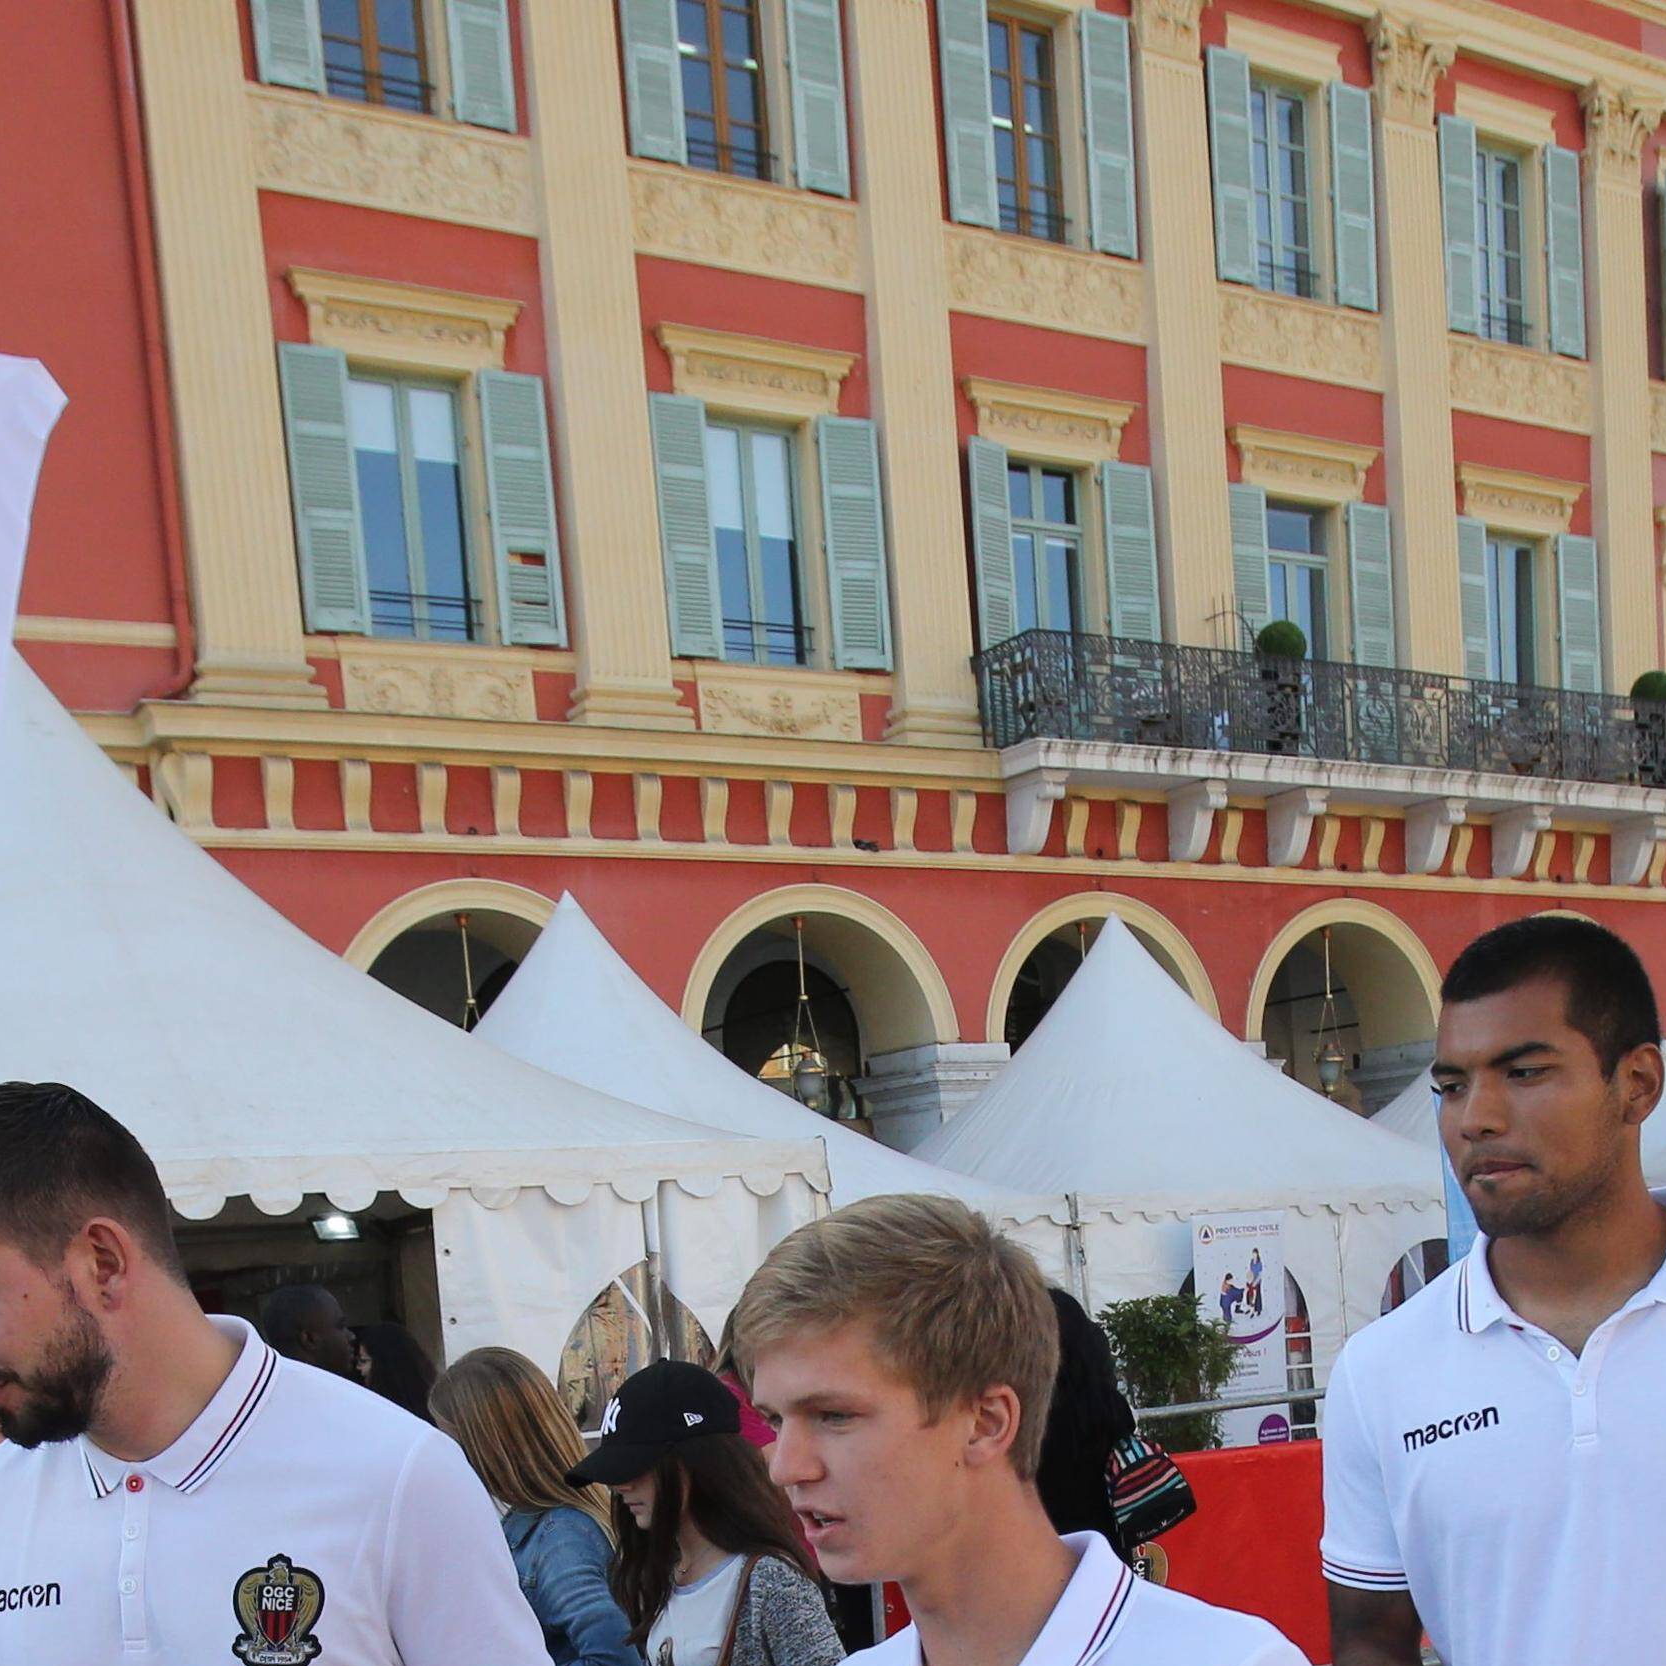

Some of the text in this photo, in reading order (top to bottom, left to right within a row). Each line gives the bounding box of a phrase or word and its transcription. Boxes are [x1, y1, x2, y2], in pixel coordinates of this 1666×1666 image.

[1403, 1404, 1501, 1454] macron
[262, 1586, 295, 1599] OGC
[262, 1598, 294, 1611] NICE
